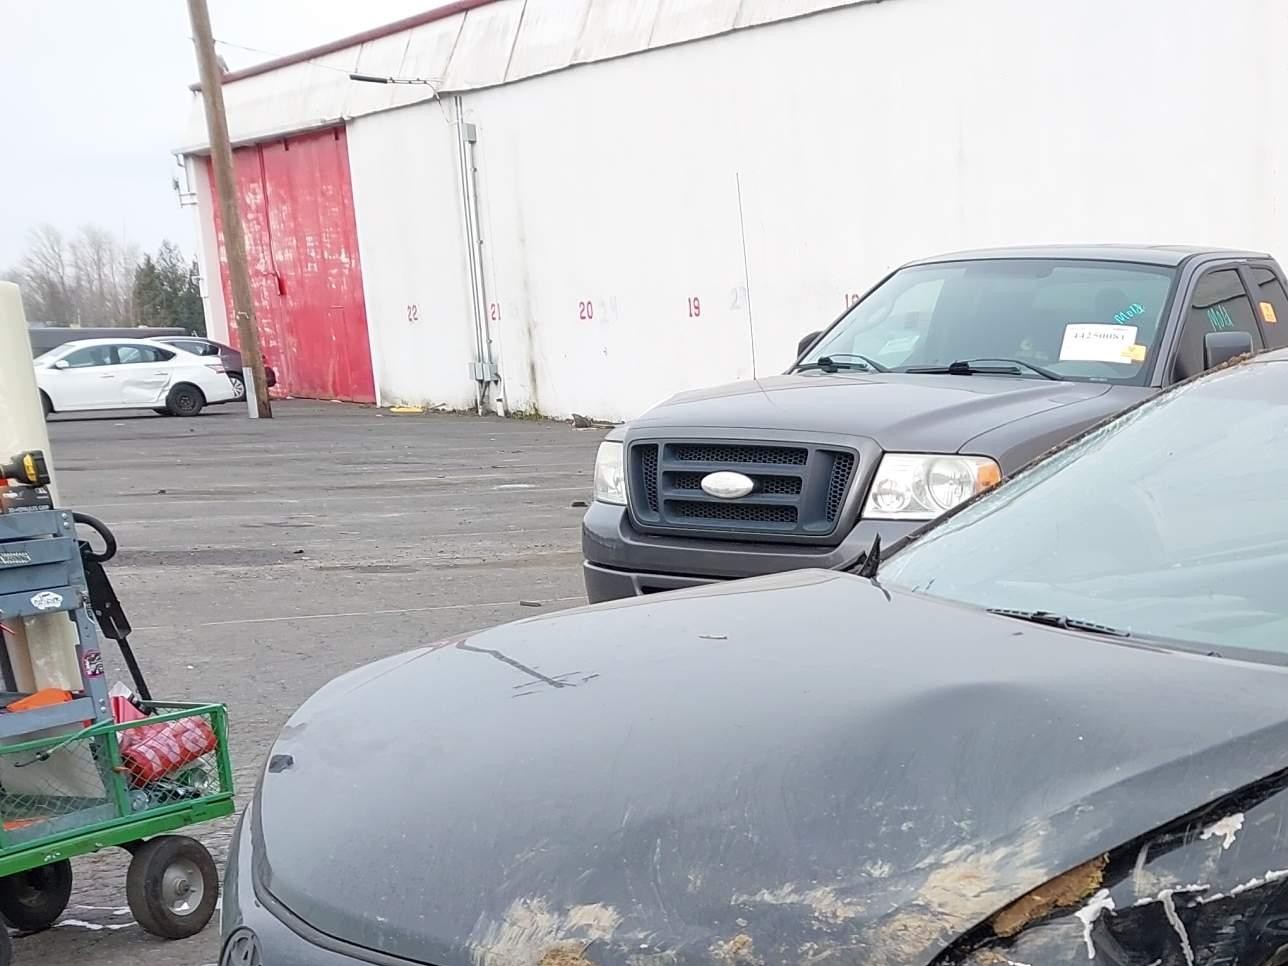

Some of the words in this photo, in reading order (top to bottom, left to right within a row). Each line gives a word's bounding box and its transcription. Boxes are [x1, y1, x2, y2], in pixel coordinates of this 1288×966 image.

[407, 304, 419, 322] 22
[490, 302, 502, 321] 21
[579, 301, 594, 320] 20
[688, 297, 701, 318] 19
